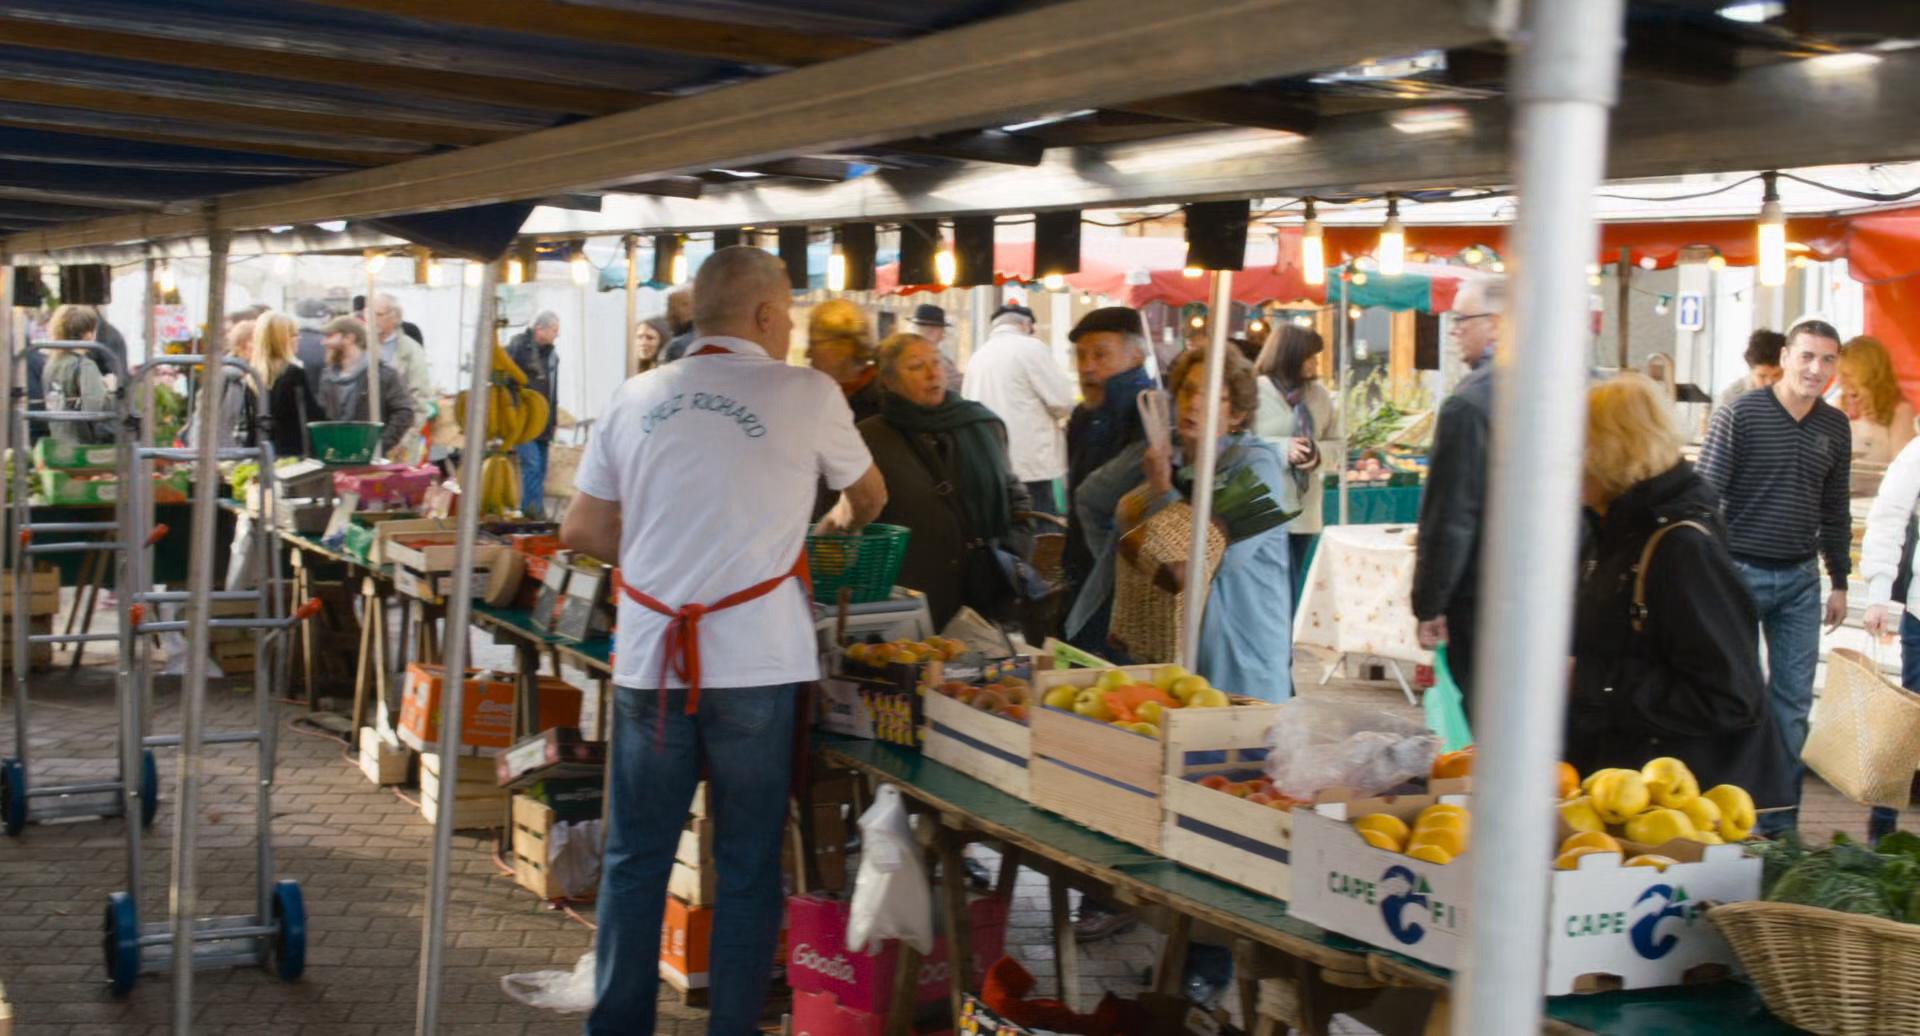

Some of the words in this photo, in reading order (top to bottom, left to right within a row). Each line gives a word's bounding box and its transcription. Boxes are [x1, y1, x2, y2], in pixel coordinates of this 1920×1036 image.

[691, 392, 767, 438] RICHARD
[1329, 871, 1377, 905] CAPE
[1567, 911, 1626, 938] CAPE
